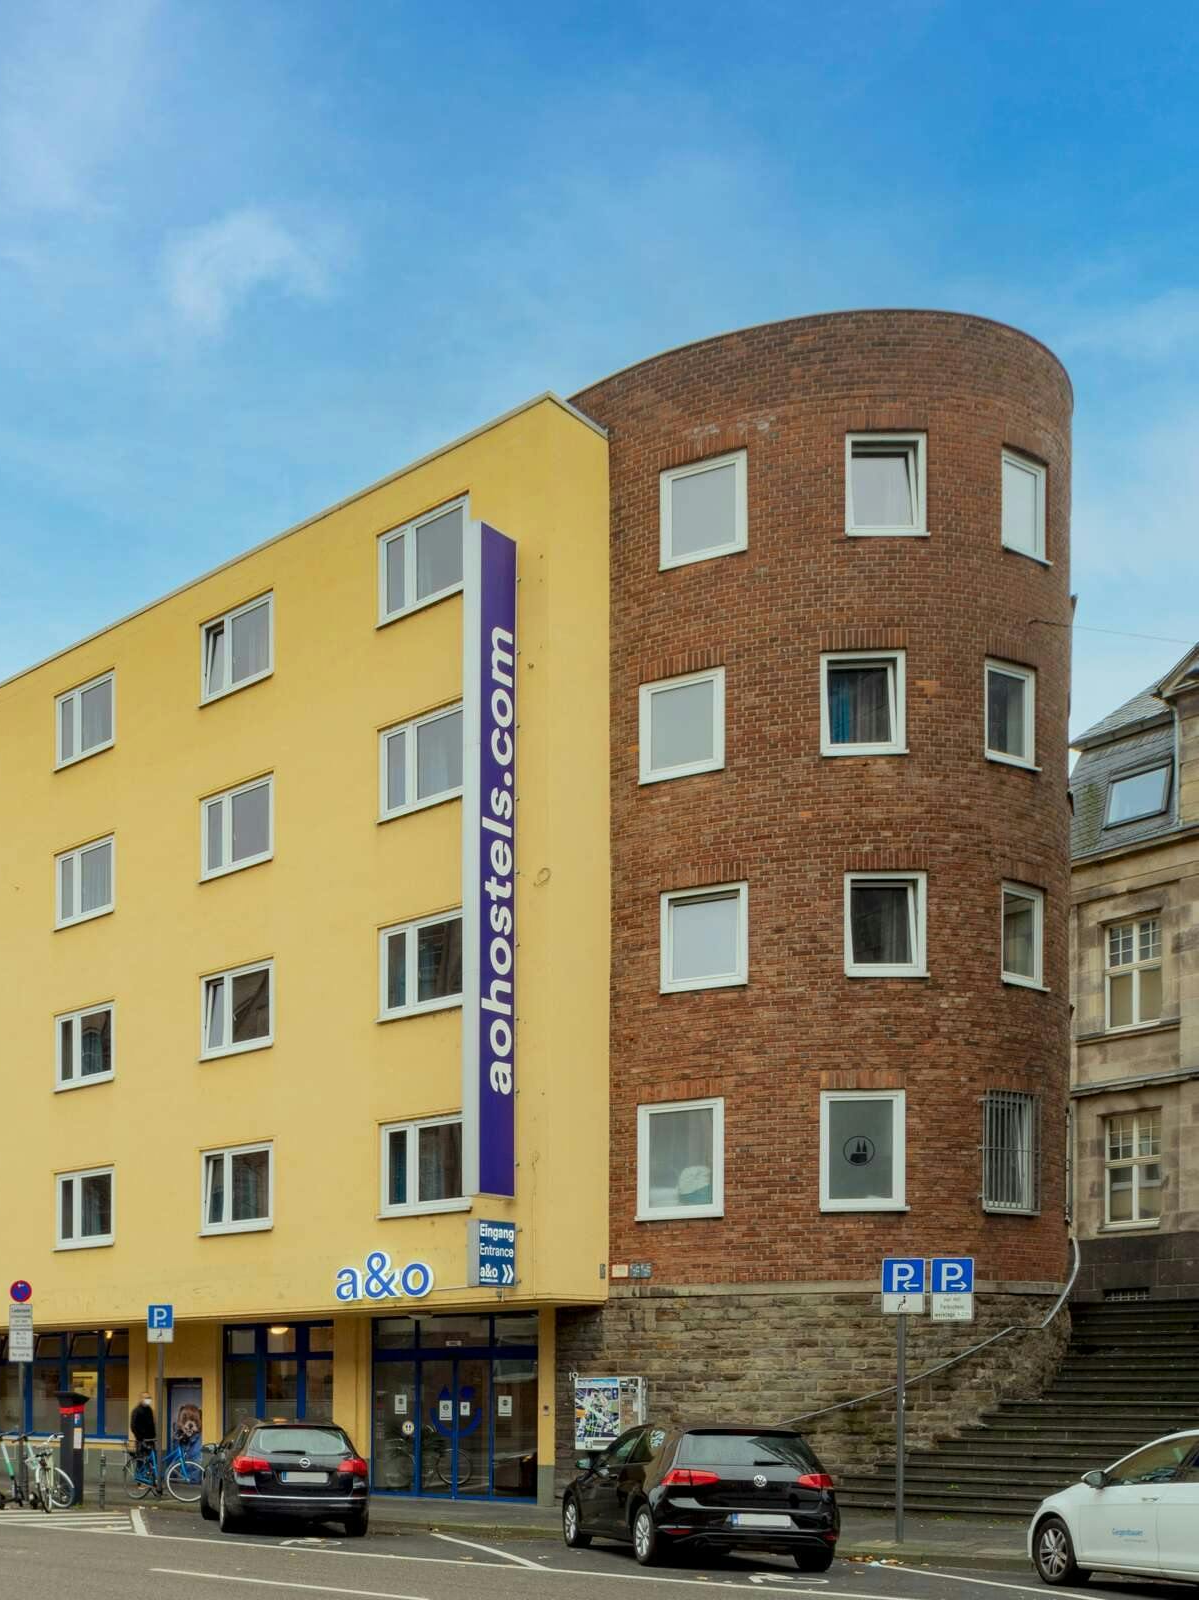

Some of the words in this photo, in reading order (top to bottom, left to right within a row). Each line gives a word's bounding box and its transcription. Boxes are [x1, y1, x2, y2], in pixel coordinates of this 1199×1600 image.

[481, 627, 513, 1095] aohostels.com
[479, 1223, 515, 1243] Eingang
[479, 1243, 514, 1258] Entrance
[336, 1251, 434, 1302] a&o
[480, 1263, 498, 1278] a&o
[892, 1263, 915, 1292] P
[941, 1263, 964, 1292] P
[153, 1307, 168, 1328] P
